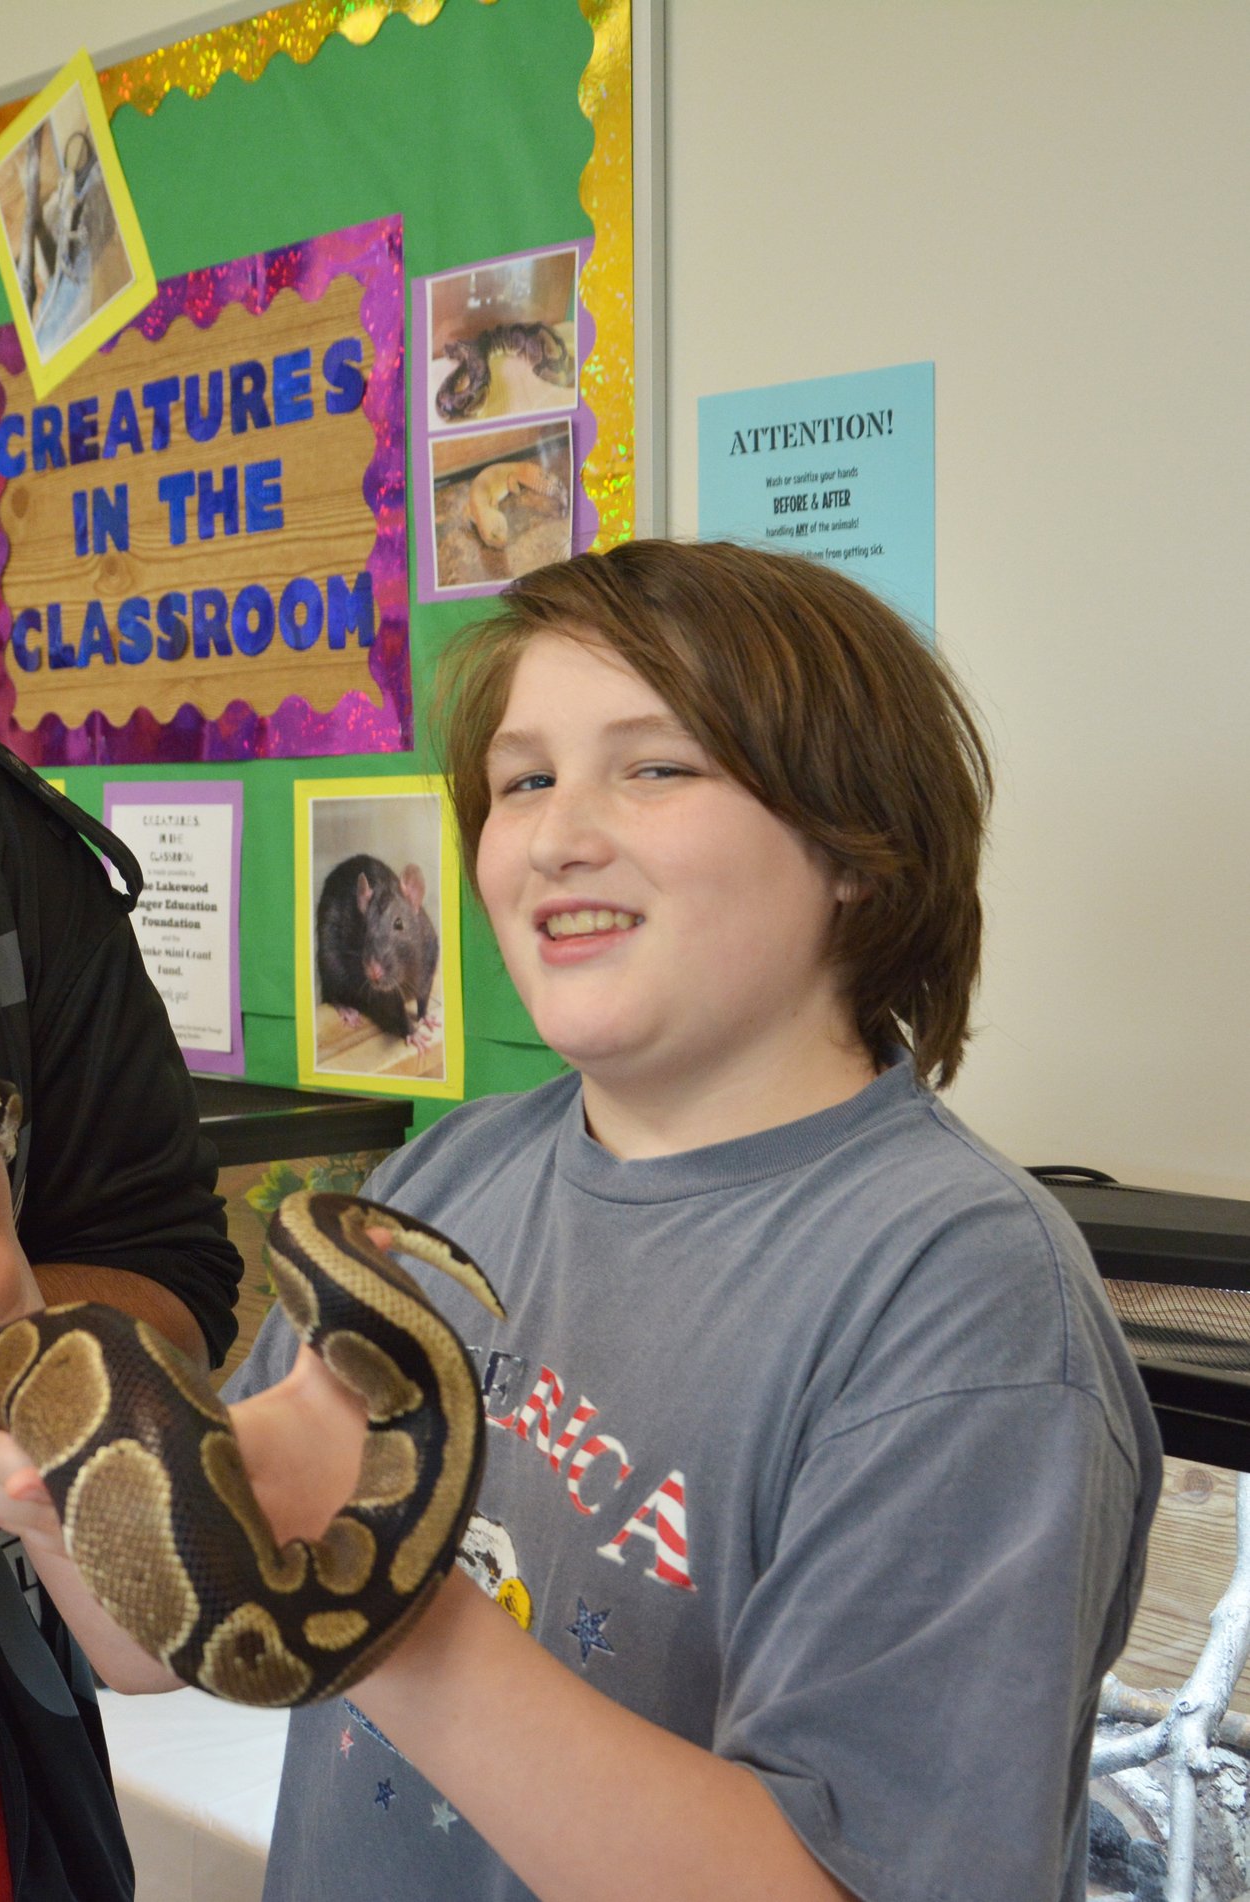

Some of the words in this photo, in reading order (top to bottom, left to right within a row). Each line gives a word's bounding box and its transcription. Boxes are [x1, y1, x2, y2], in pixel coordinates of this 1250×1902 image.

[729, 408, 894, 455] ATTENTION!
[820, 470, 836, 484] your
[837, 466, 859, 480] hands
[72, 484, 130, 557] IN
[158, 458, 285, 546] THE
[773, 493, 809, 514] BEFORE
[811, 492, 819, 510] &
[822, 488, 852, 509] AFTER
[766, 524, 794, 538] handling
[795, 523, 809, 537] ANY
[843, 544, 869, 560] getting
[12, 572, 376, 672] CLASSROOM
[156, 881, 209, 894] Lakewood
[165, 900, 218, 913] Education
[141, 916, 202, 930] Foundation
